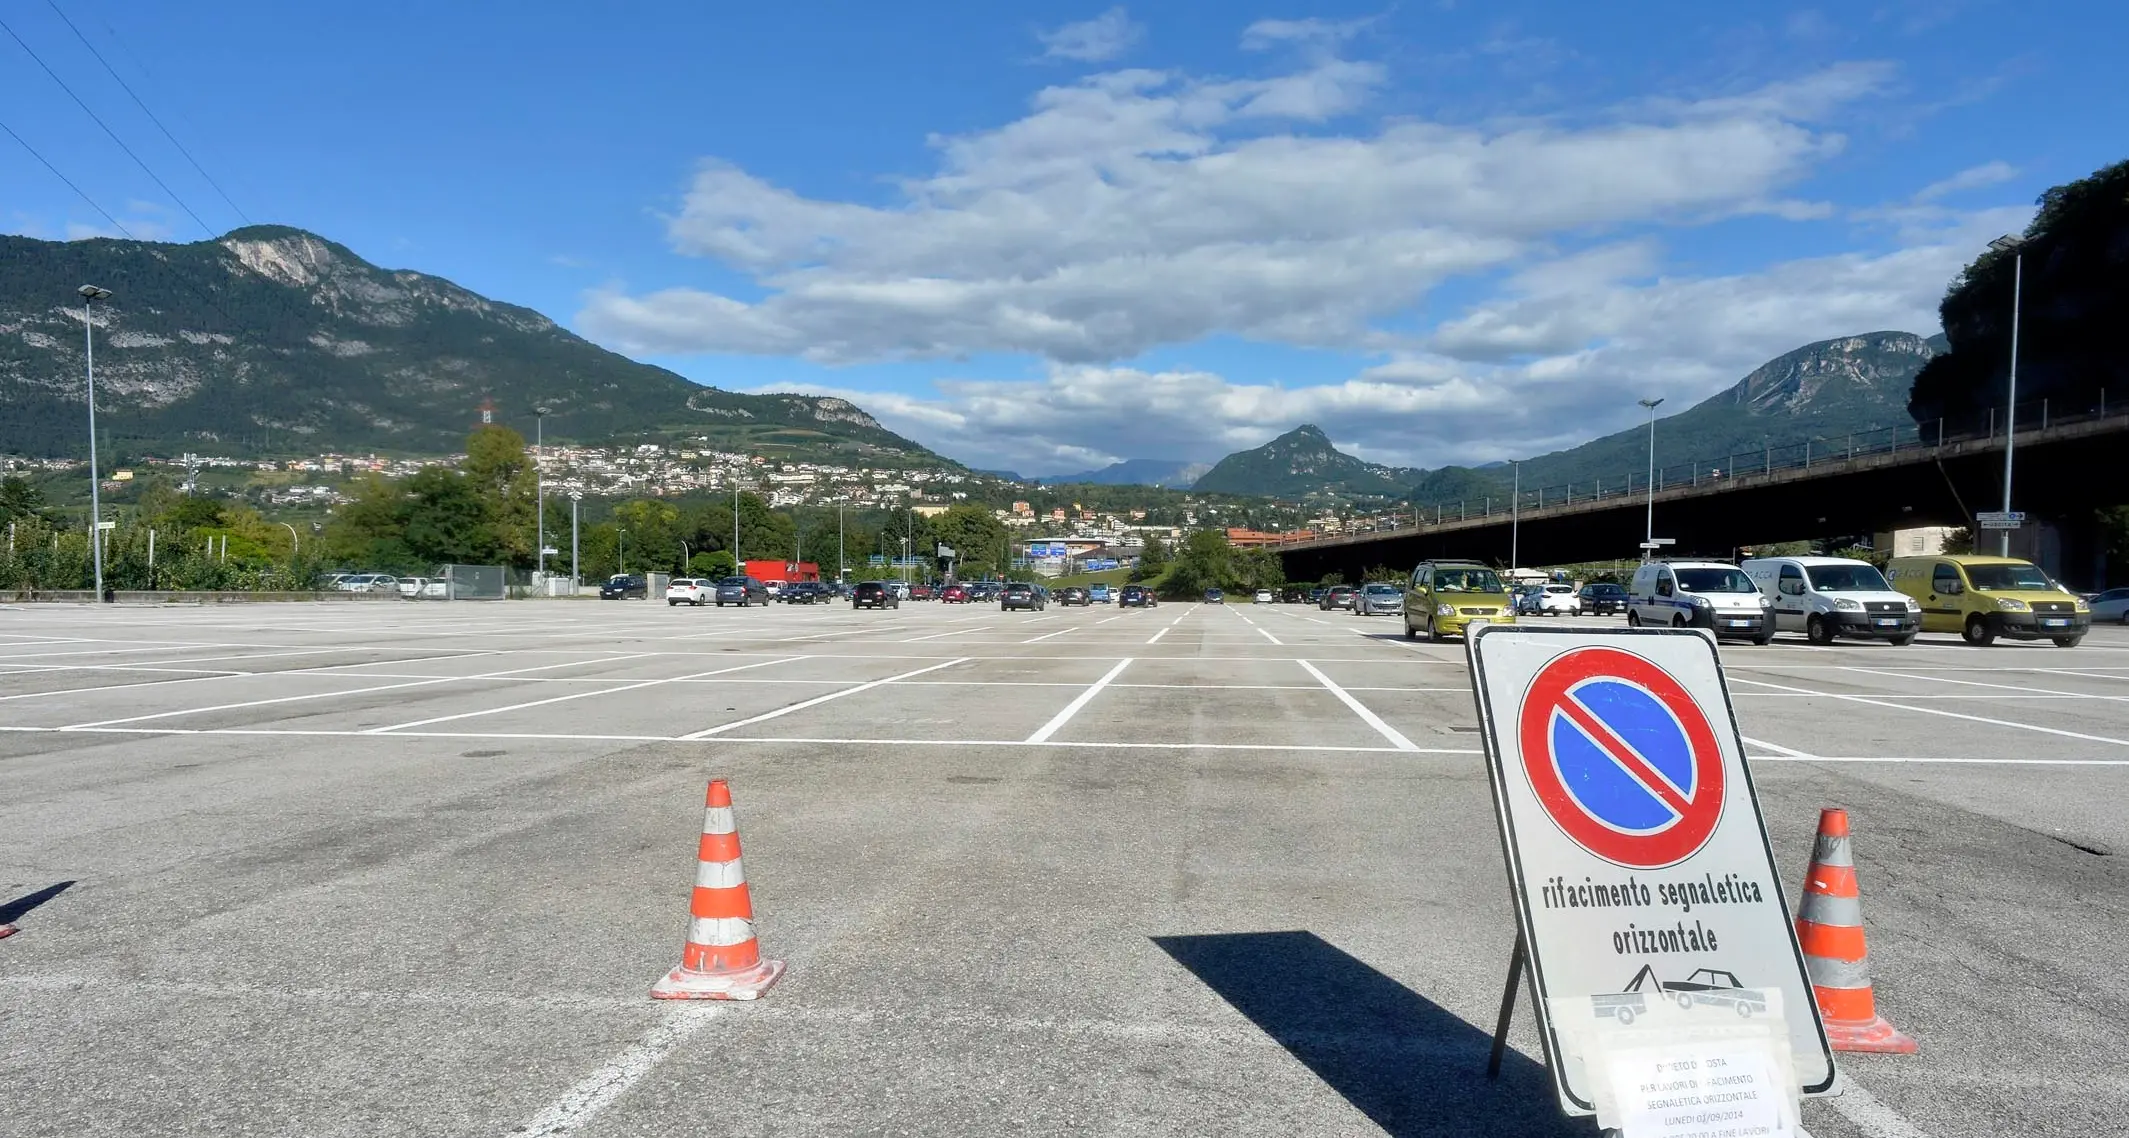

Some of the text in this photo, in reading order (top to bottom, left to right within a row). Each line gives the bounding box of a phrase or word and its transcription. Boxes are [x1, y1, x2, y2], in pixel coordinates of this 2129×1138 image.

[1542, 872, 1763, 913] rifacimento segnaletica
[1613, 919, 1718, 955] orizzontale
[1704, 1058, 1728, 1069] OSTA
[1657, 1080, 1688, 1092] LAVORI
[1689, 1079, 1698, 1089] DI
[1647, 1090, 1758, 1110] SEGNALETICA ORIZZONTALE
[1719, 1128, 1737, 1138] FINE
[1738, 1126, 1770, 1137] LAVORI
